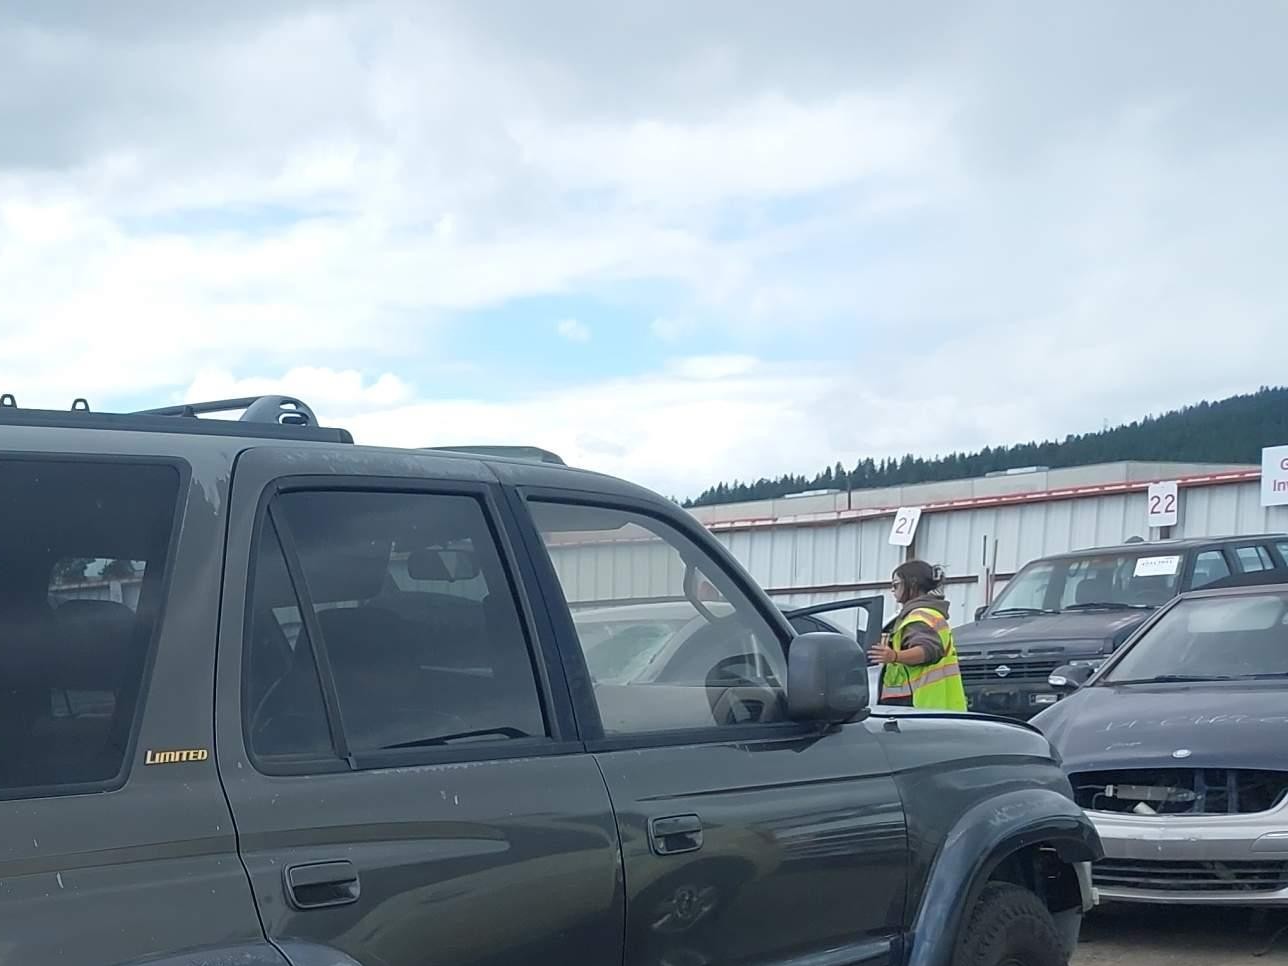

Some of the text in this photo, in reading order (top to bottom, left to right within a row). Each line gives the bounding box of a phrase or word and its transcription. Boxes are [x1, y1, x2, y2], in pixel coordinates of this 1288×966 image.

[1150, 494, 1175, 515] 22
[895, 516, 915, 535] 21
[145, 749, 208, 765] LIMITED
